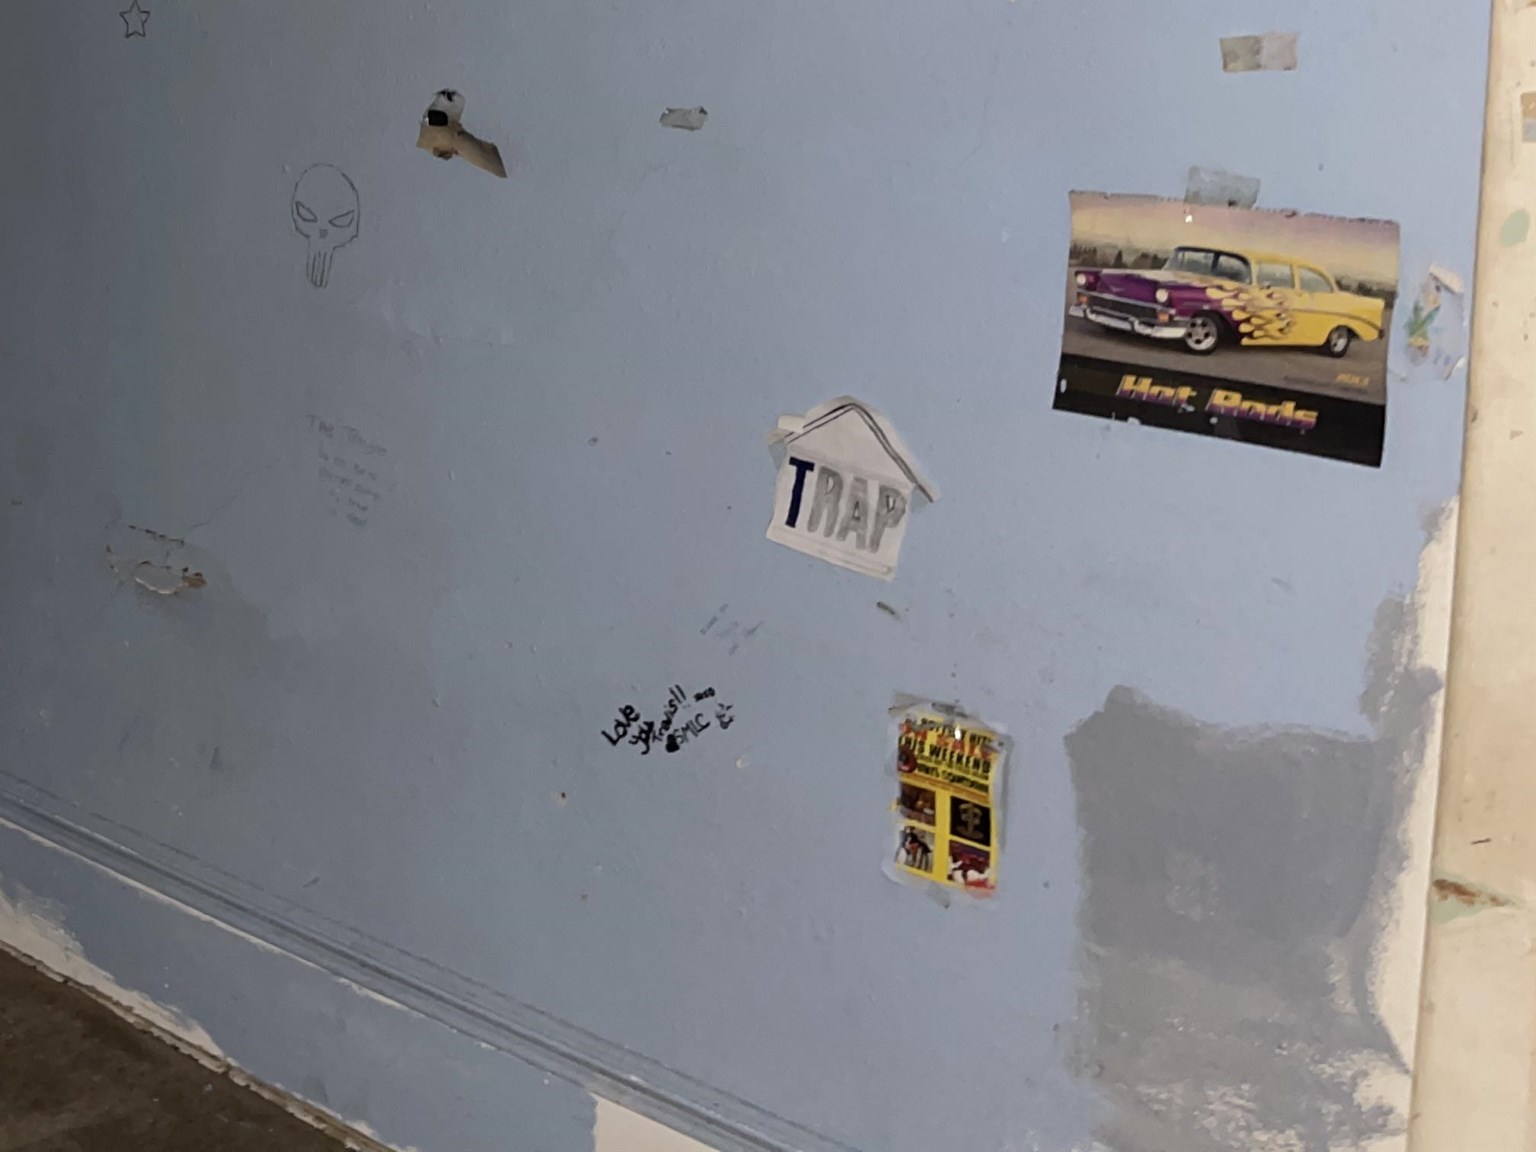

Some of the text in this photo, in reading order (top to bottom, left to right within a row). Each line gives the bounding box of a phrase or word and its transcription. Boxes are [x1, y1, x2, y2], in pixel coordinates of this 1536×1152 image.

[1116, 373, 1198, 409] Hot
[784, 456, 908, 554] TRAP
[601, 704, 641, 747] Love
